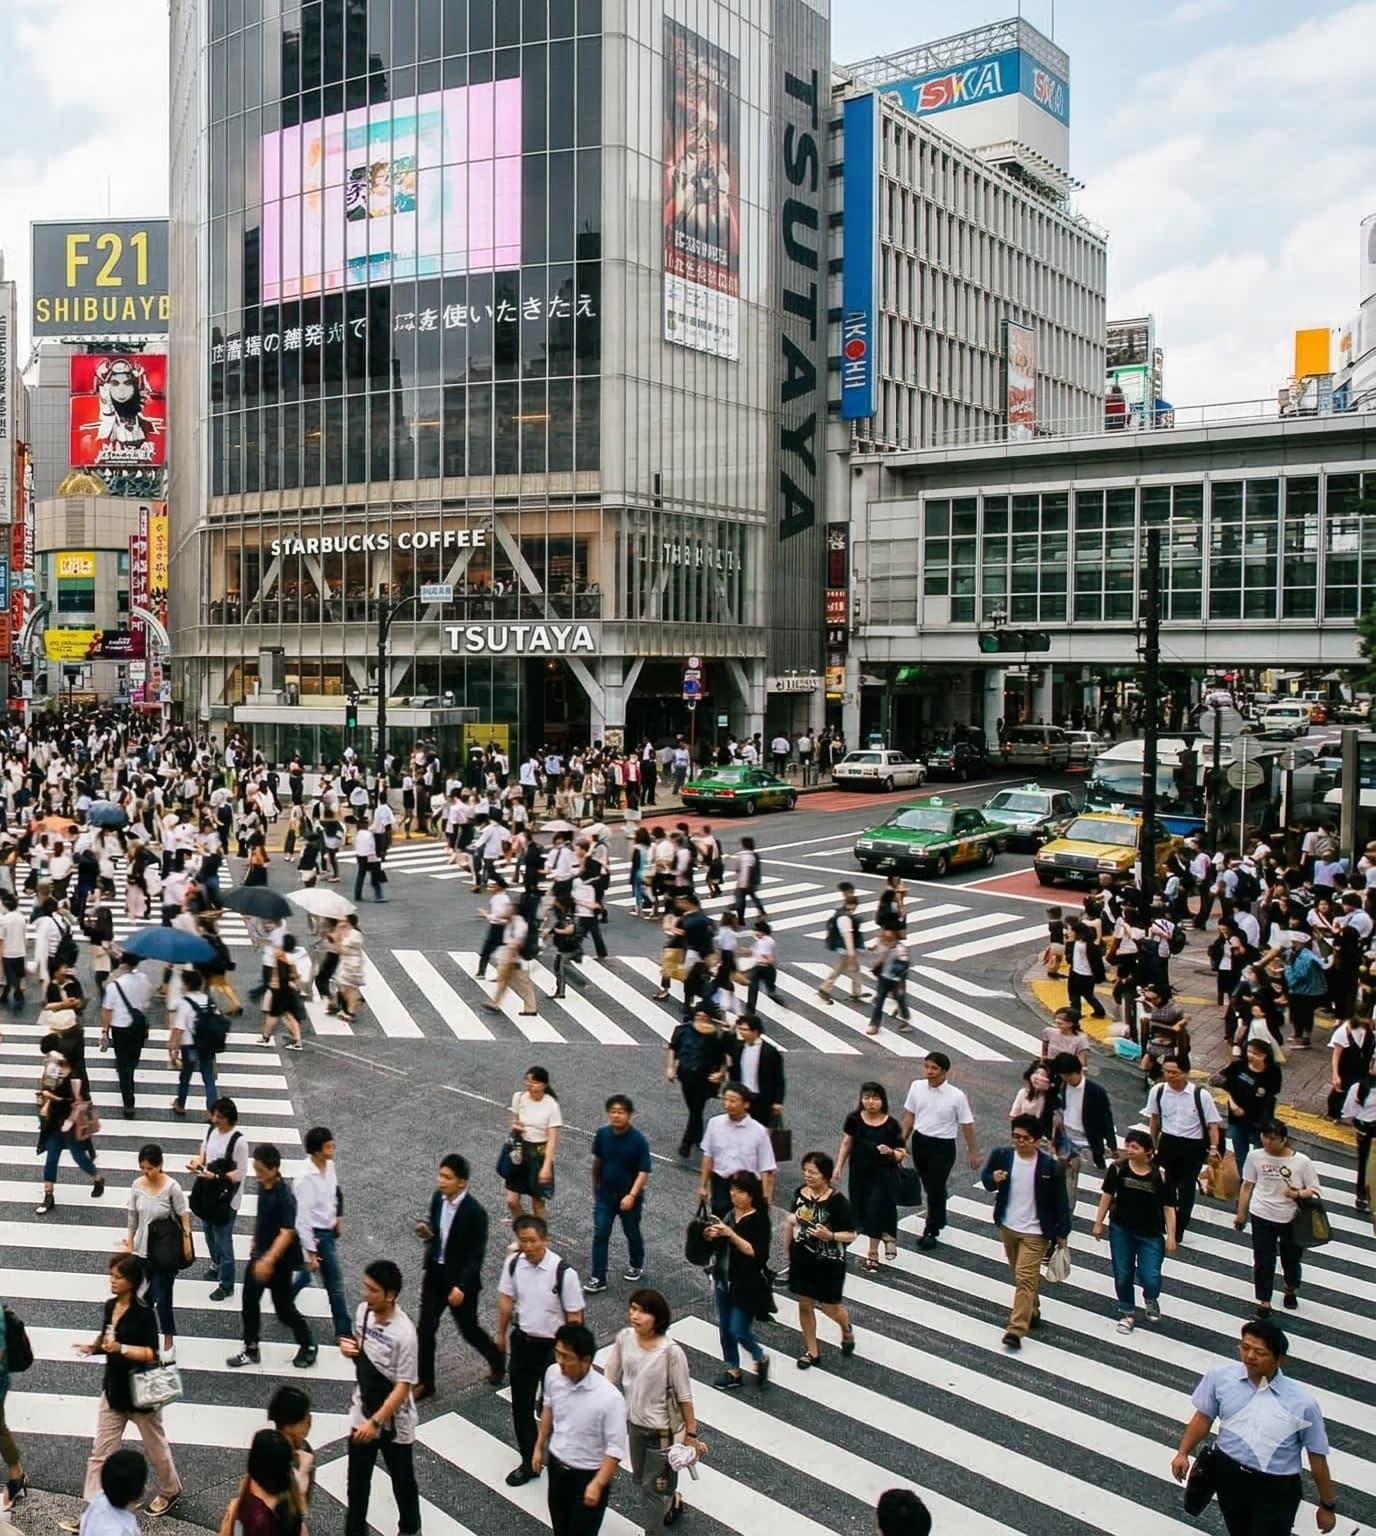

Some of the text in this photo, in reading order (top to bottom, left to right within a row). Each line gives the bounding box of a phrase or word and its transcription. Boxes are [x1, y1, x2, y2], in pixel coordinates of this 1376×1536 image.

[66, 232, 147, 288] F21
[779, 68, 819, 541] TSUTAYA
[271, 529, 486, 557] STARBUCKS COFFEE
[444, 625, 595, 652] TSUTAYA
